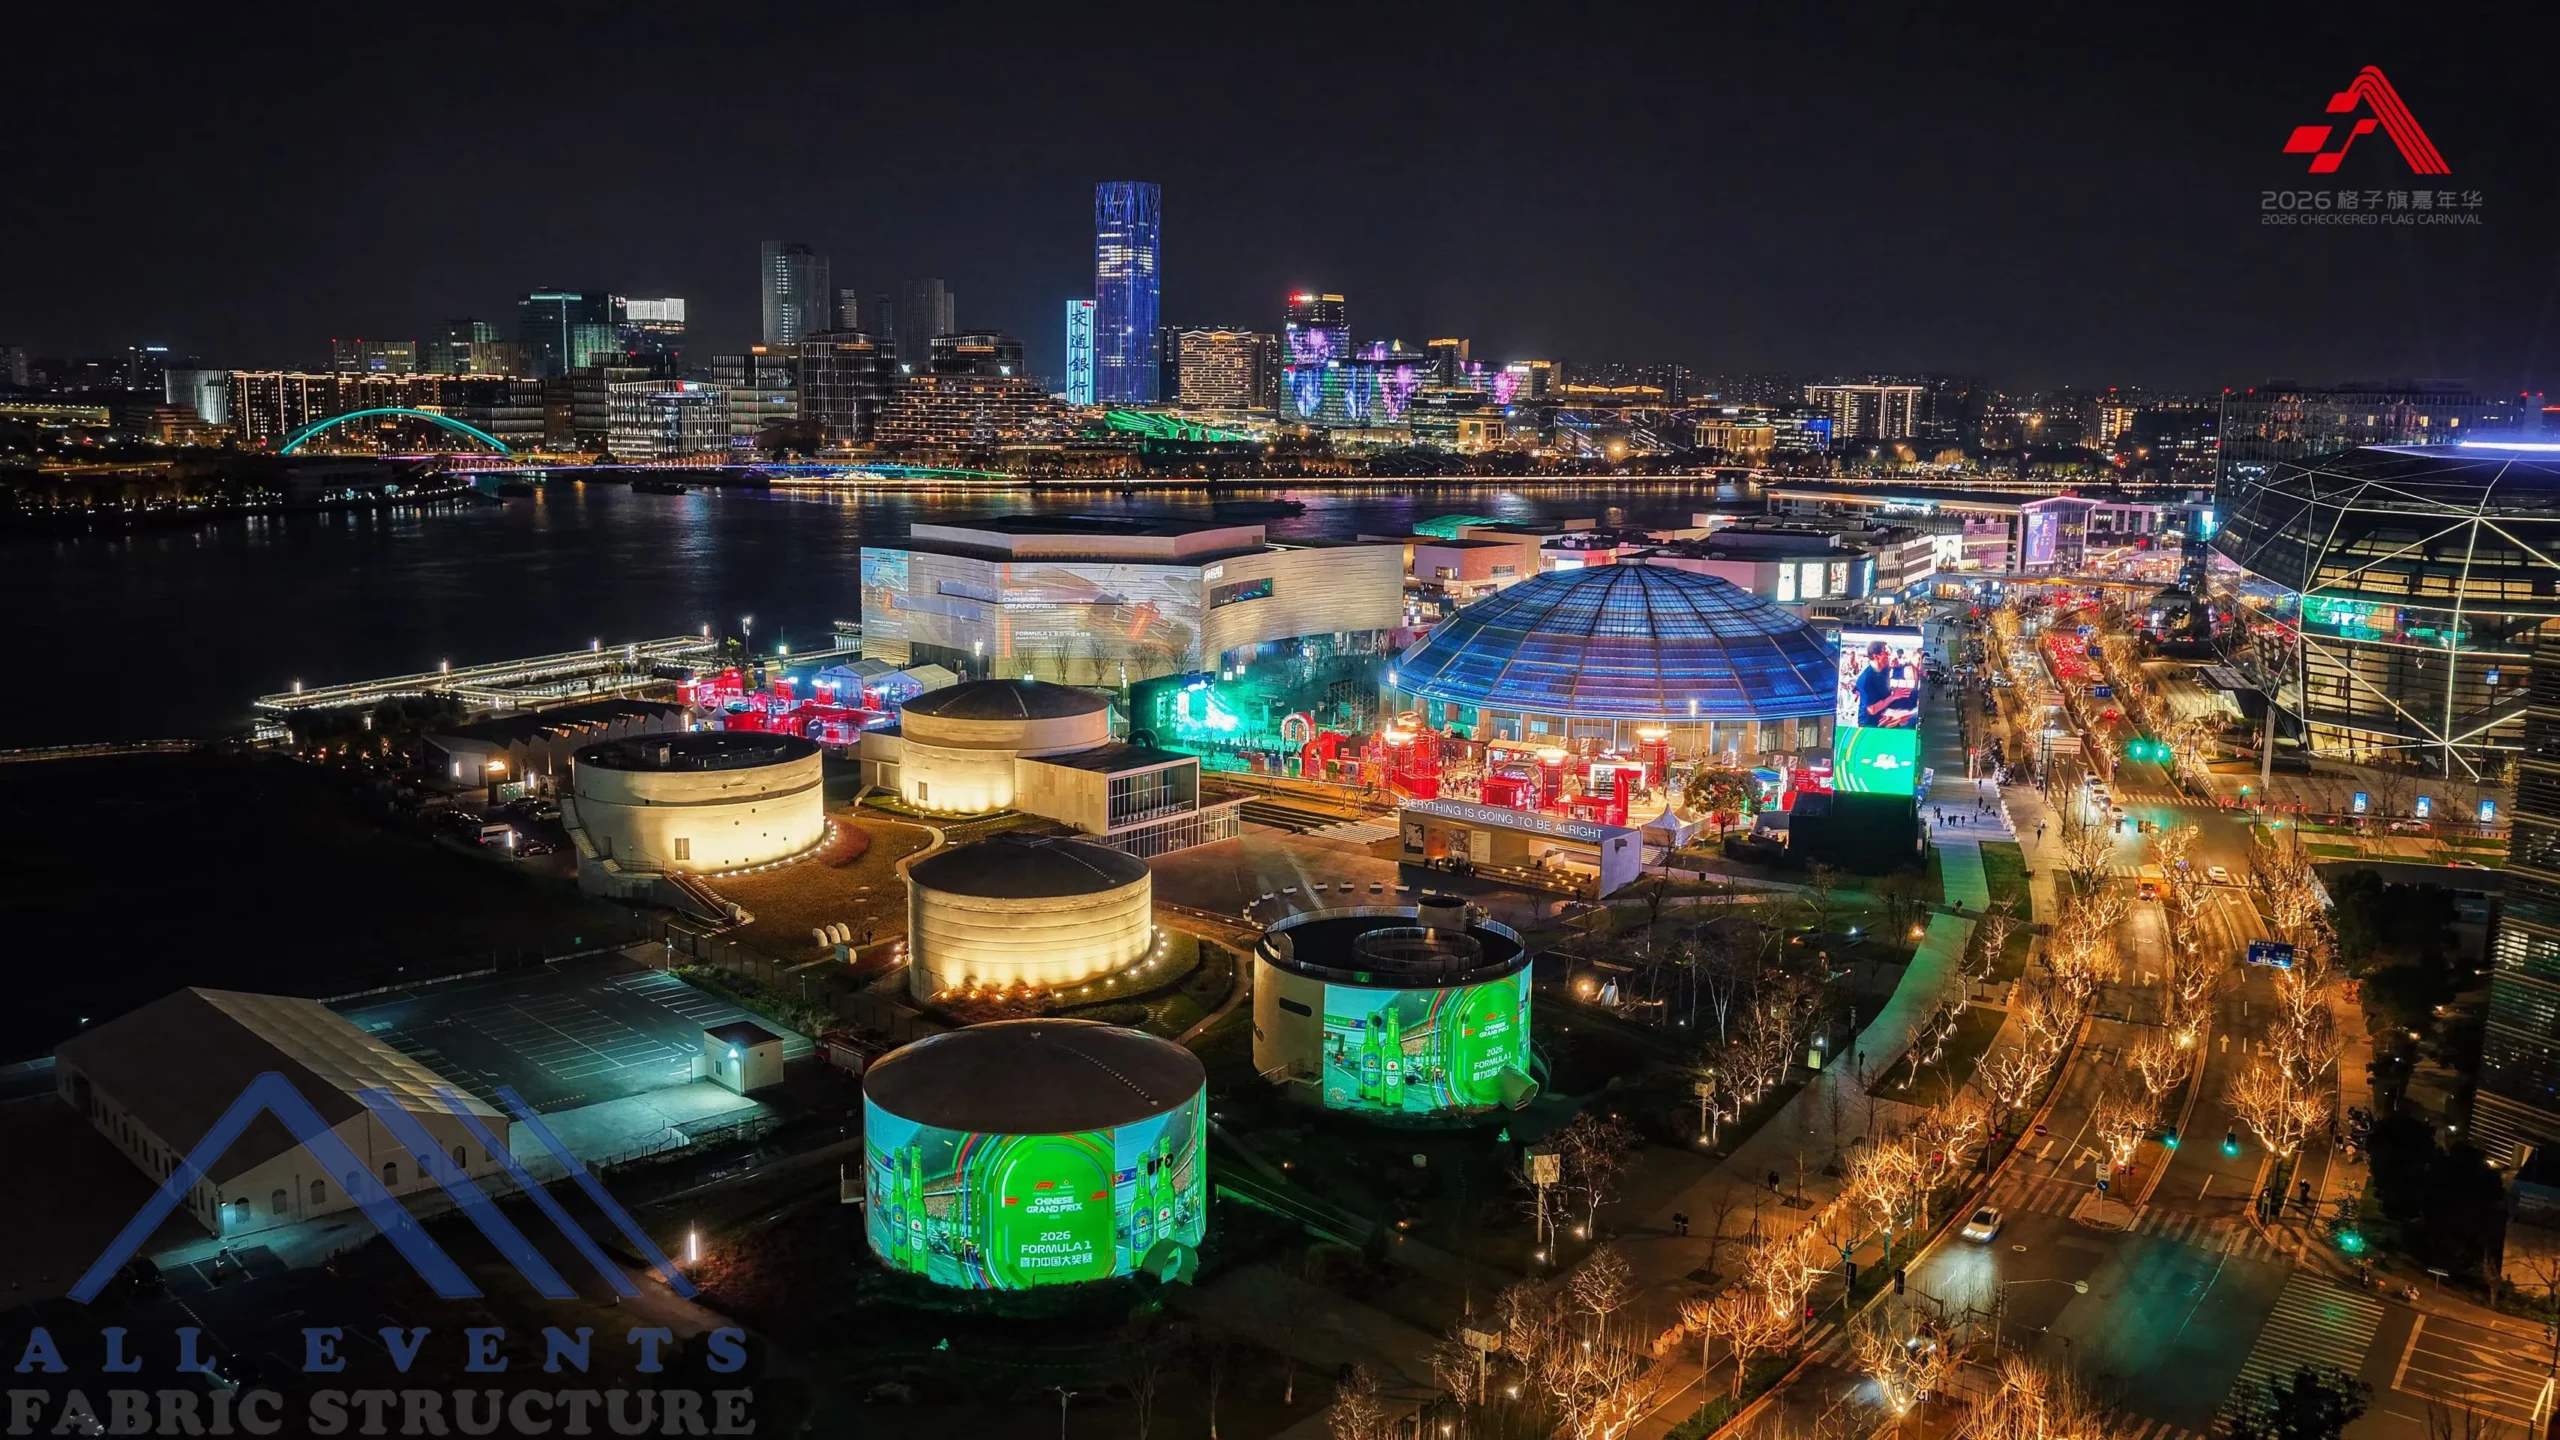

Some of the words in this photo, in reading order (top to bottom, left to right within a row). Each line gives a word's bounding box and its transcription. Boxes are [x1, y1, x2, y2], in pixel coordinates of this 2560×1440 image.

[1121, 811, 1145, 824] TANK
[1464, 808, 1475, 818] IS
[1478, 809, 1513, 825] GOING
[1518, 816, 1533, 828] TO
[1537, 819, 1551, 831] BE
[1555, 823, 1604, 839] ALRIGHT
[1486, 1044, 1504, 1057] 2026
[1474, 1053, 1508, 1070] FORMULA
[1034, 1195, 1074, 1205] CHINESE
[1026, 1205, 1060, 1214] GRAND
[1060, 1202, 1083, 1213] PRIX
[1040, 1230, 1071, 1241] 2026
[1021, 1241, 1082, 1254] FORMULA
[1084, 1240, 1092, 1250] 1
